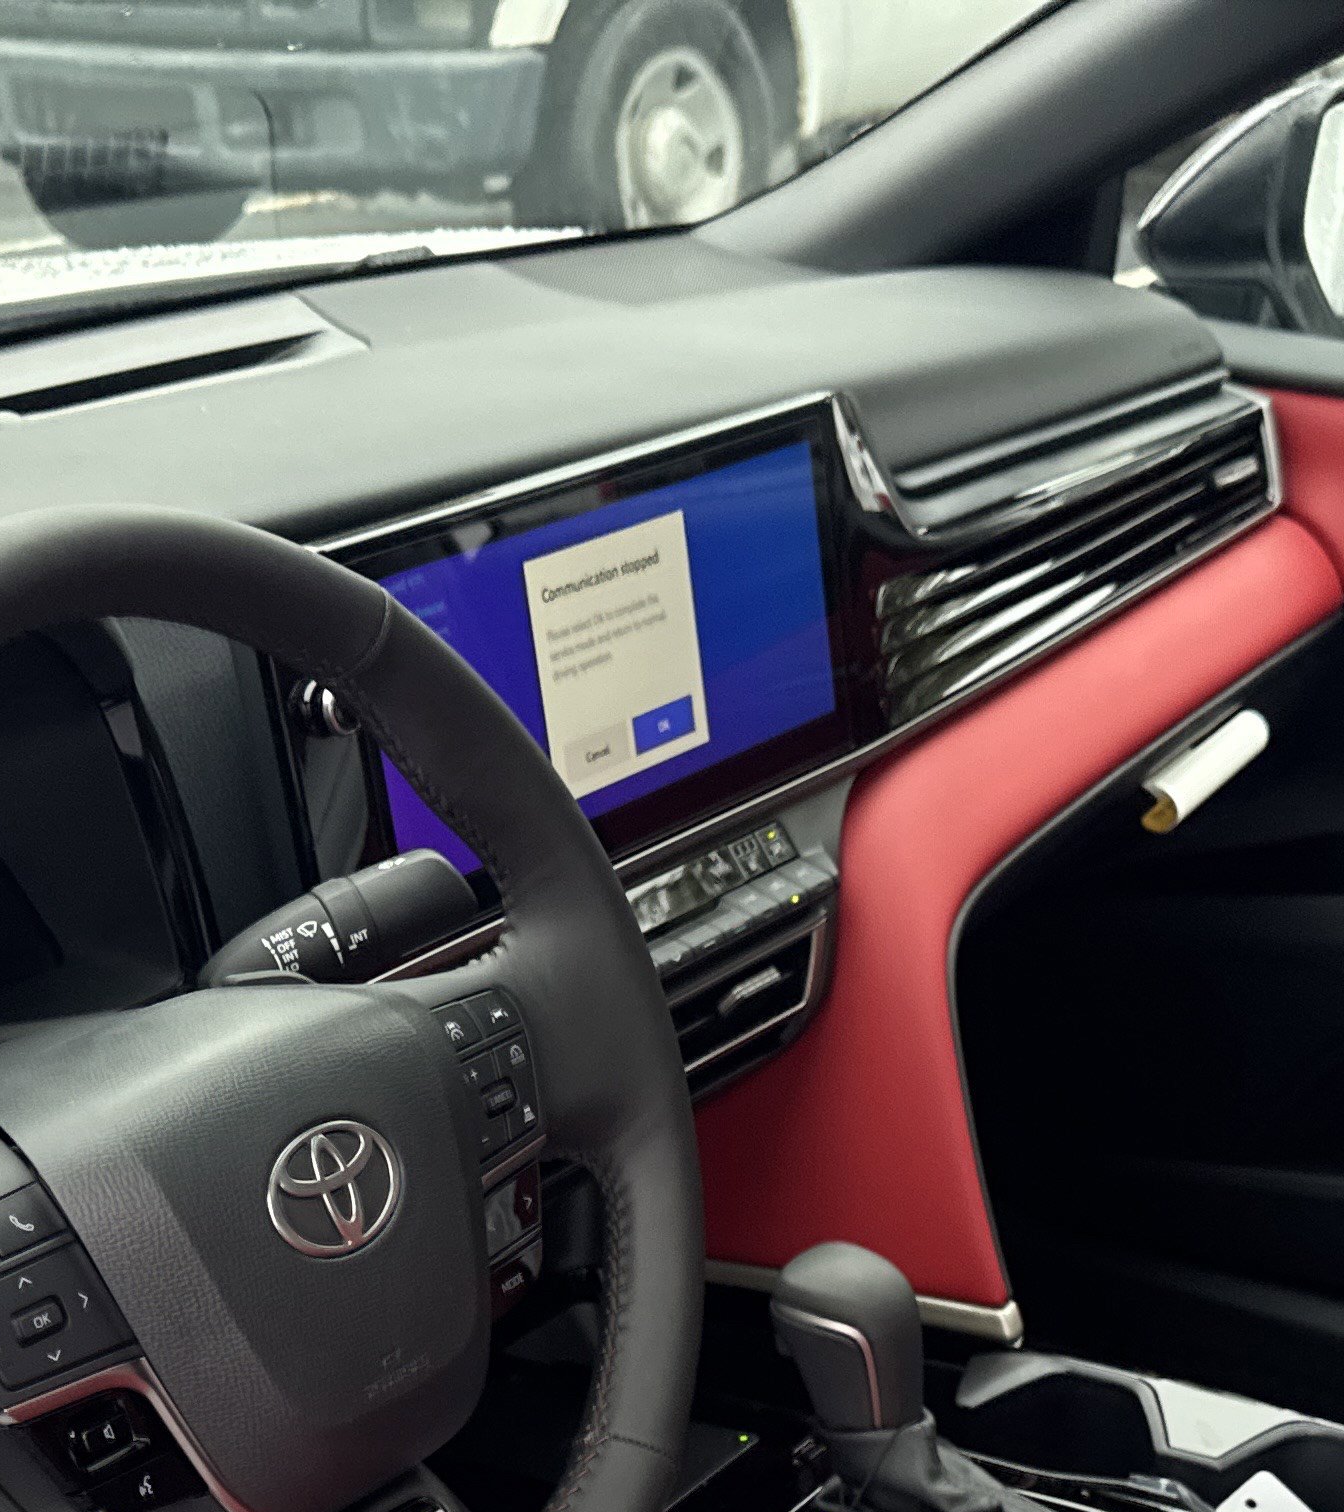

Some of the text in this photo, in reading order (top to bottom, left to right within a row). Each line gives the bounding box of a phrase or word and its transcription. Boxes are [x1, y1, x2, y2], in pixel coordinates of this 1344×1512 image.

[541, 548, 660, 604] Communication stopped
[269, 926, 294, 945] MIST
[276, 938, 297, 954] OFF
[282, 949, 300, 964] INT
[32, 1312, 52, 1330] OK
